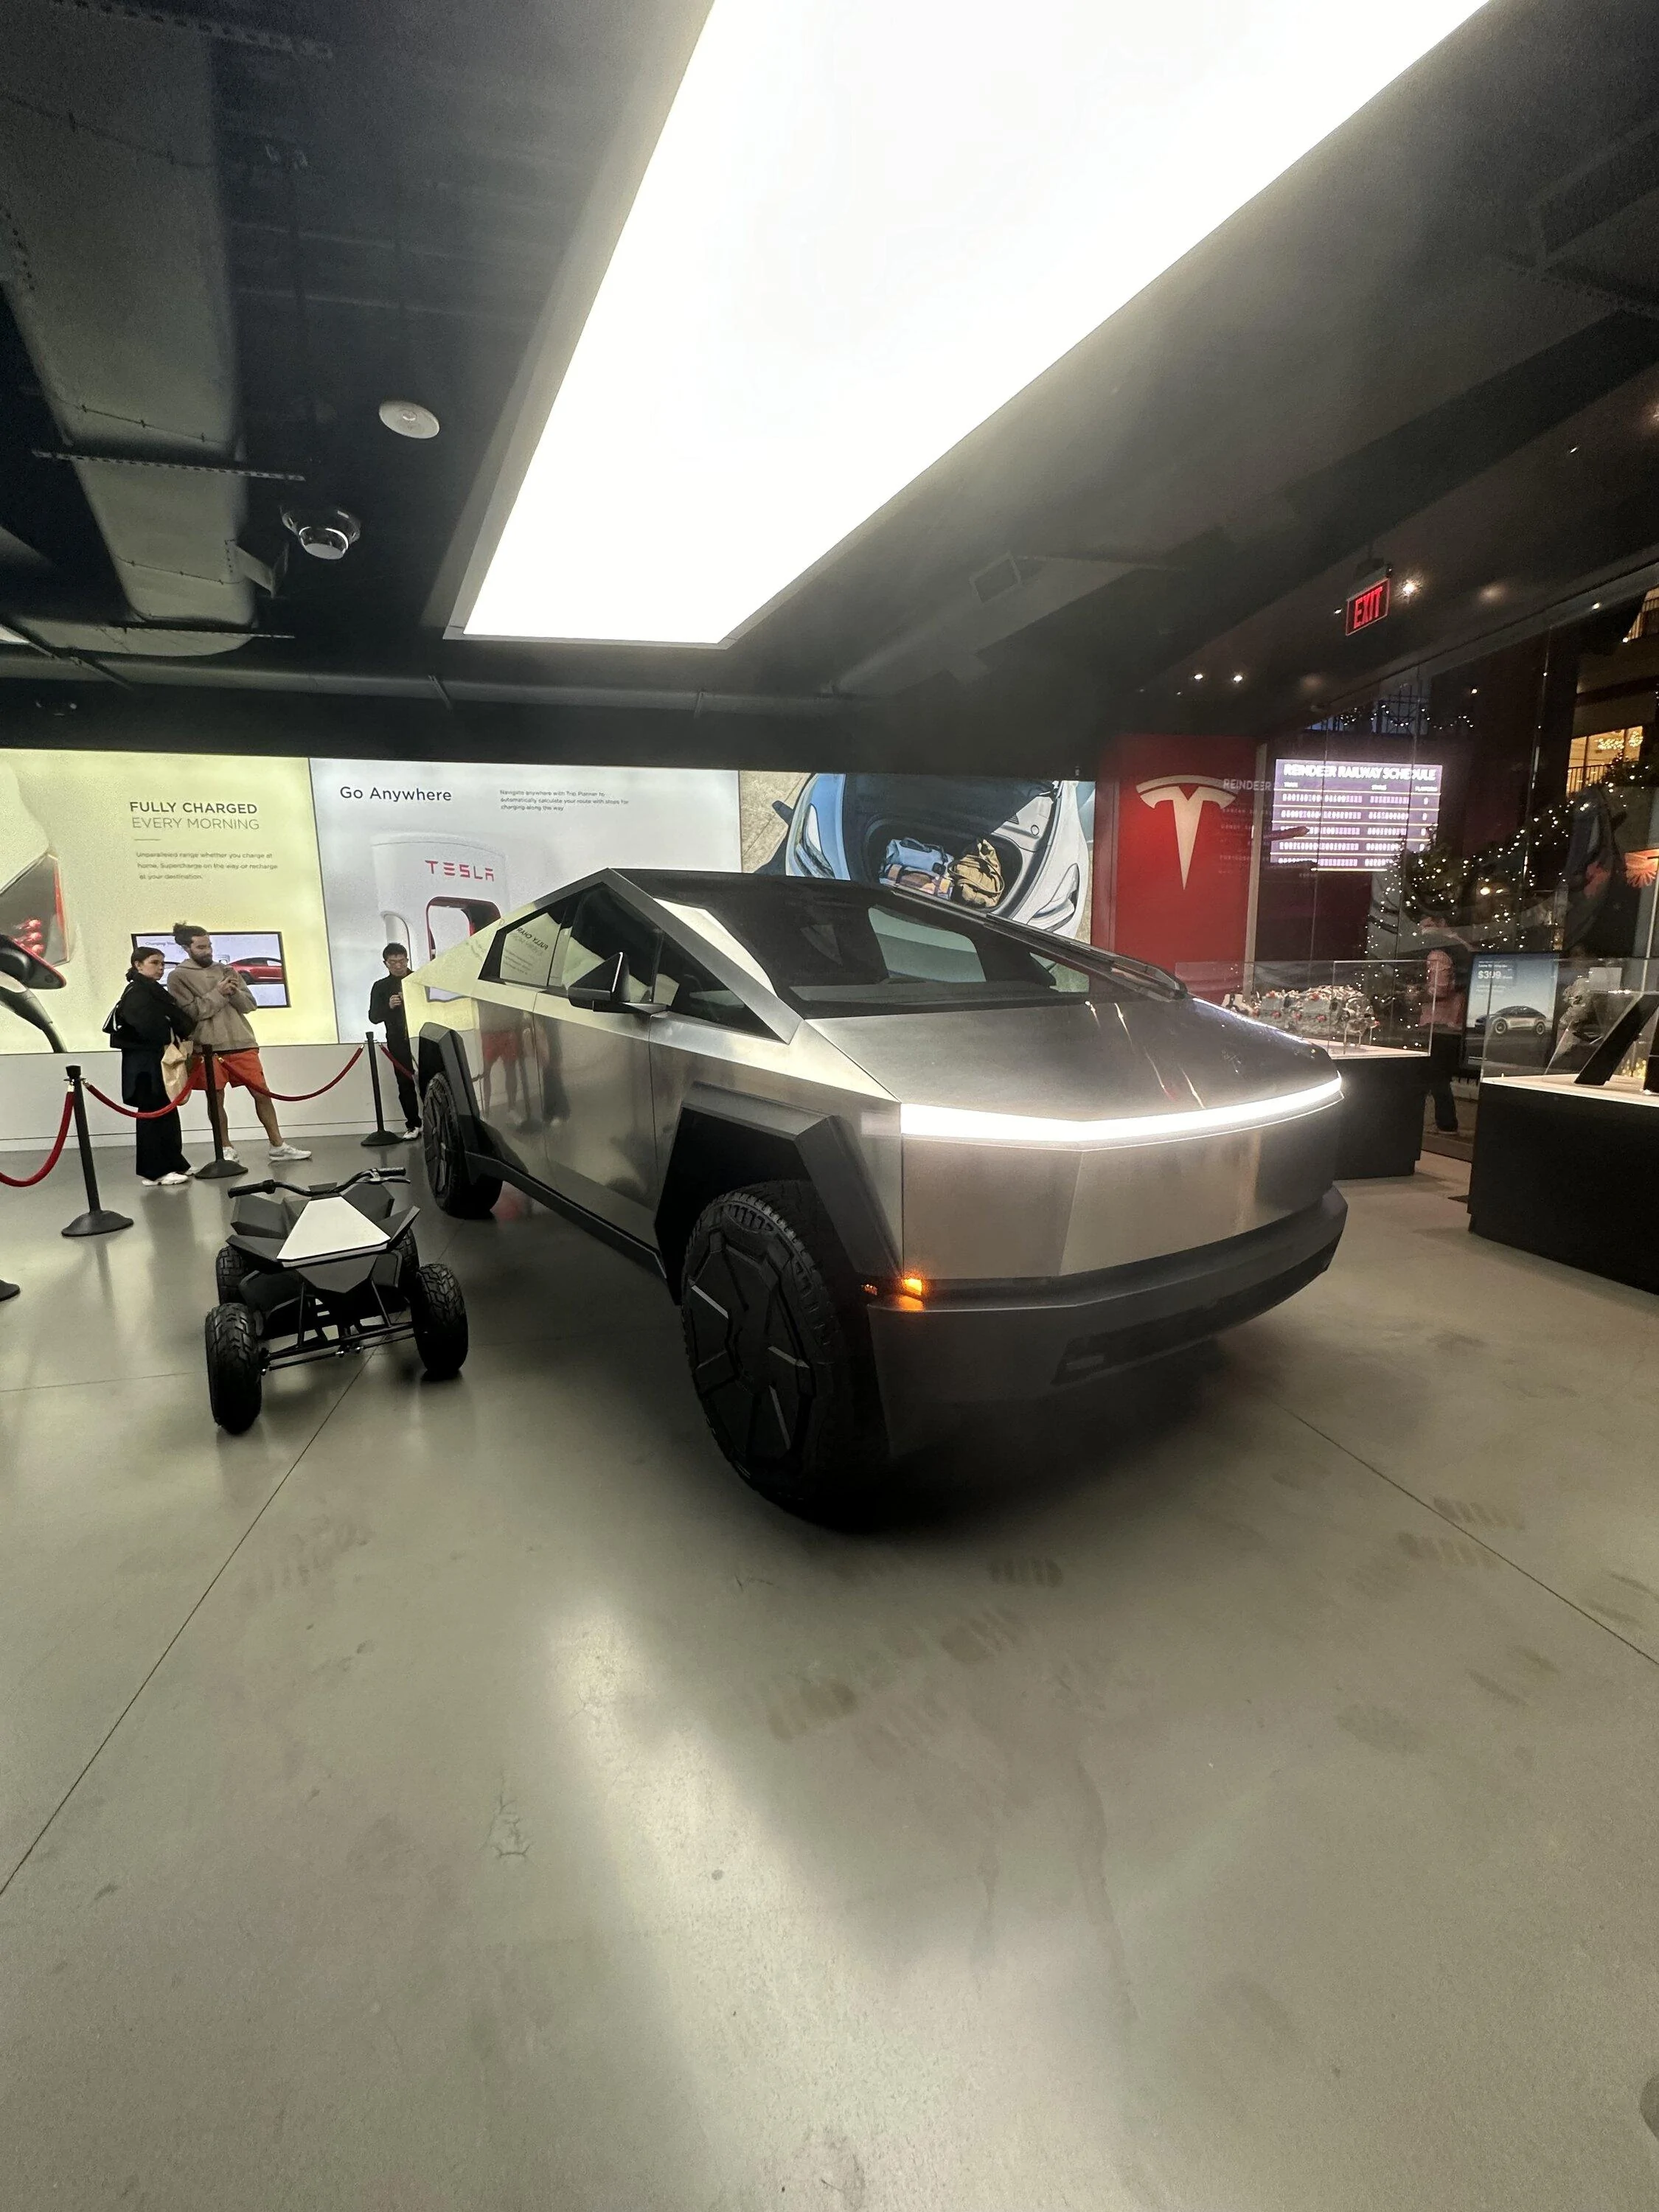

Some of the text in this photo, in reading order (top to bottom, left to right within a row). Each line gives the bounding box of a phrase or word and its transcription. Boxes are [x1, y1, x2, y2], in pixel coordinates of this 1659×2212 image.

[1353, 586, 1383, 629] EXIT
[1283, 764, 1337, 778] REINDEER
[1338, 765, 1384, 779] RAILWAY
[340, 786, 452, 802] Go Anywhere
[130, 801, 257, 814] FULLY CHARGED
[132, 816, 260, 830] EVERY MORNING
[425, 860, 494, 882] TESLA
